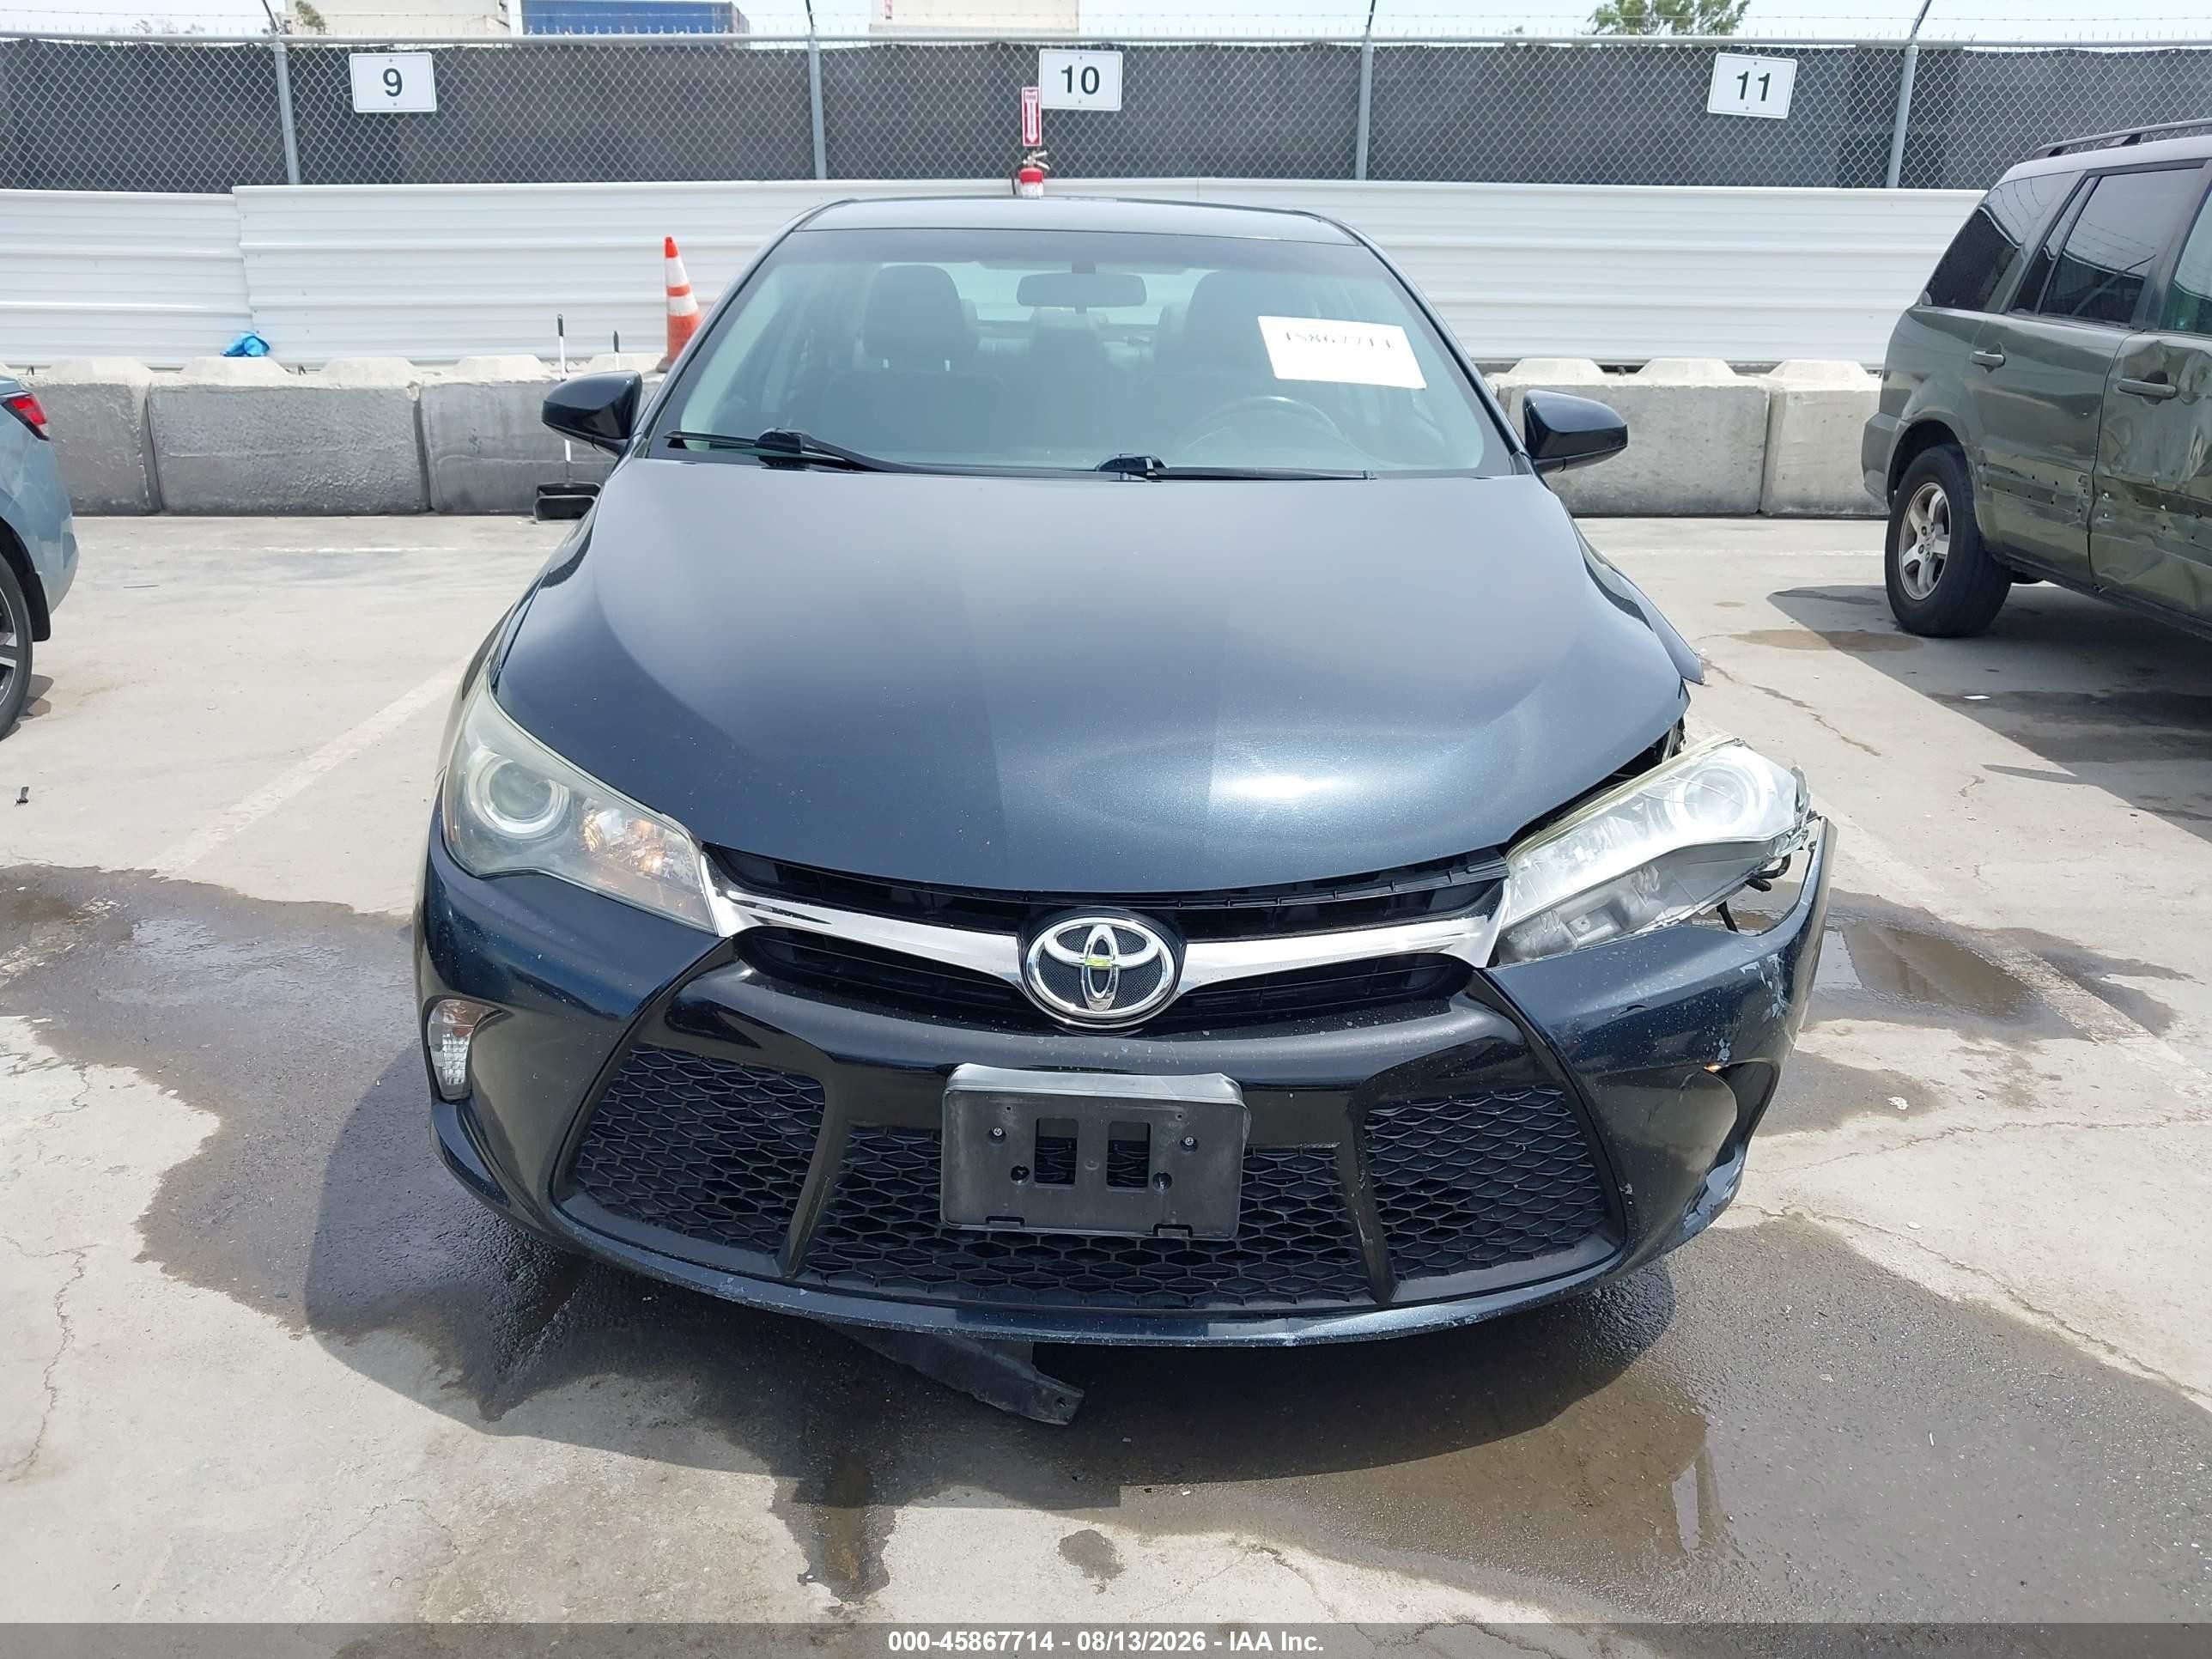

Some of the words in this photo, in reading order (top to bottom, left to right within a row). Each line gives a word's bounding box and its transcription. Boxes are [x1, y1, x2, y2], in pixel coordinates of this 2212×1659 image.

[382, 68, 403, 97] 9
[1060, 65, 1100, 95] 10
[1736, 70, 1771, 102] 11
